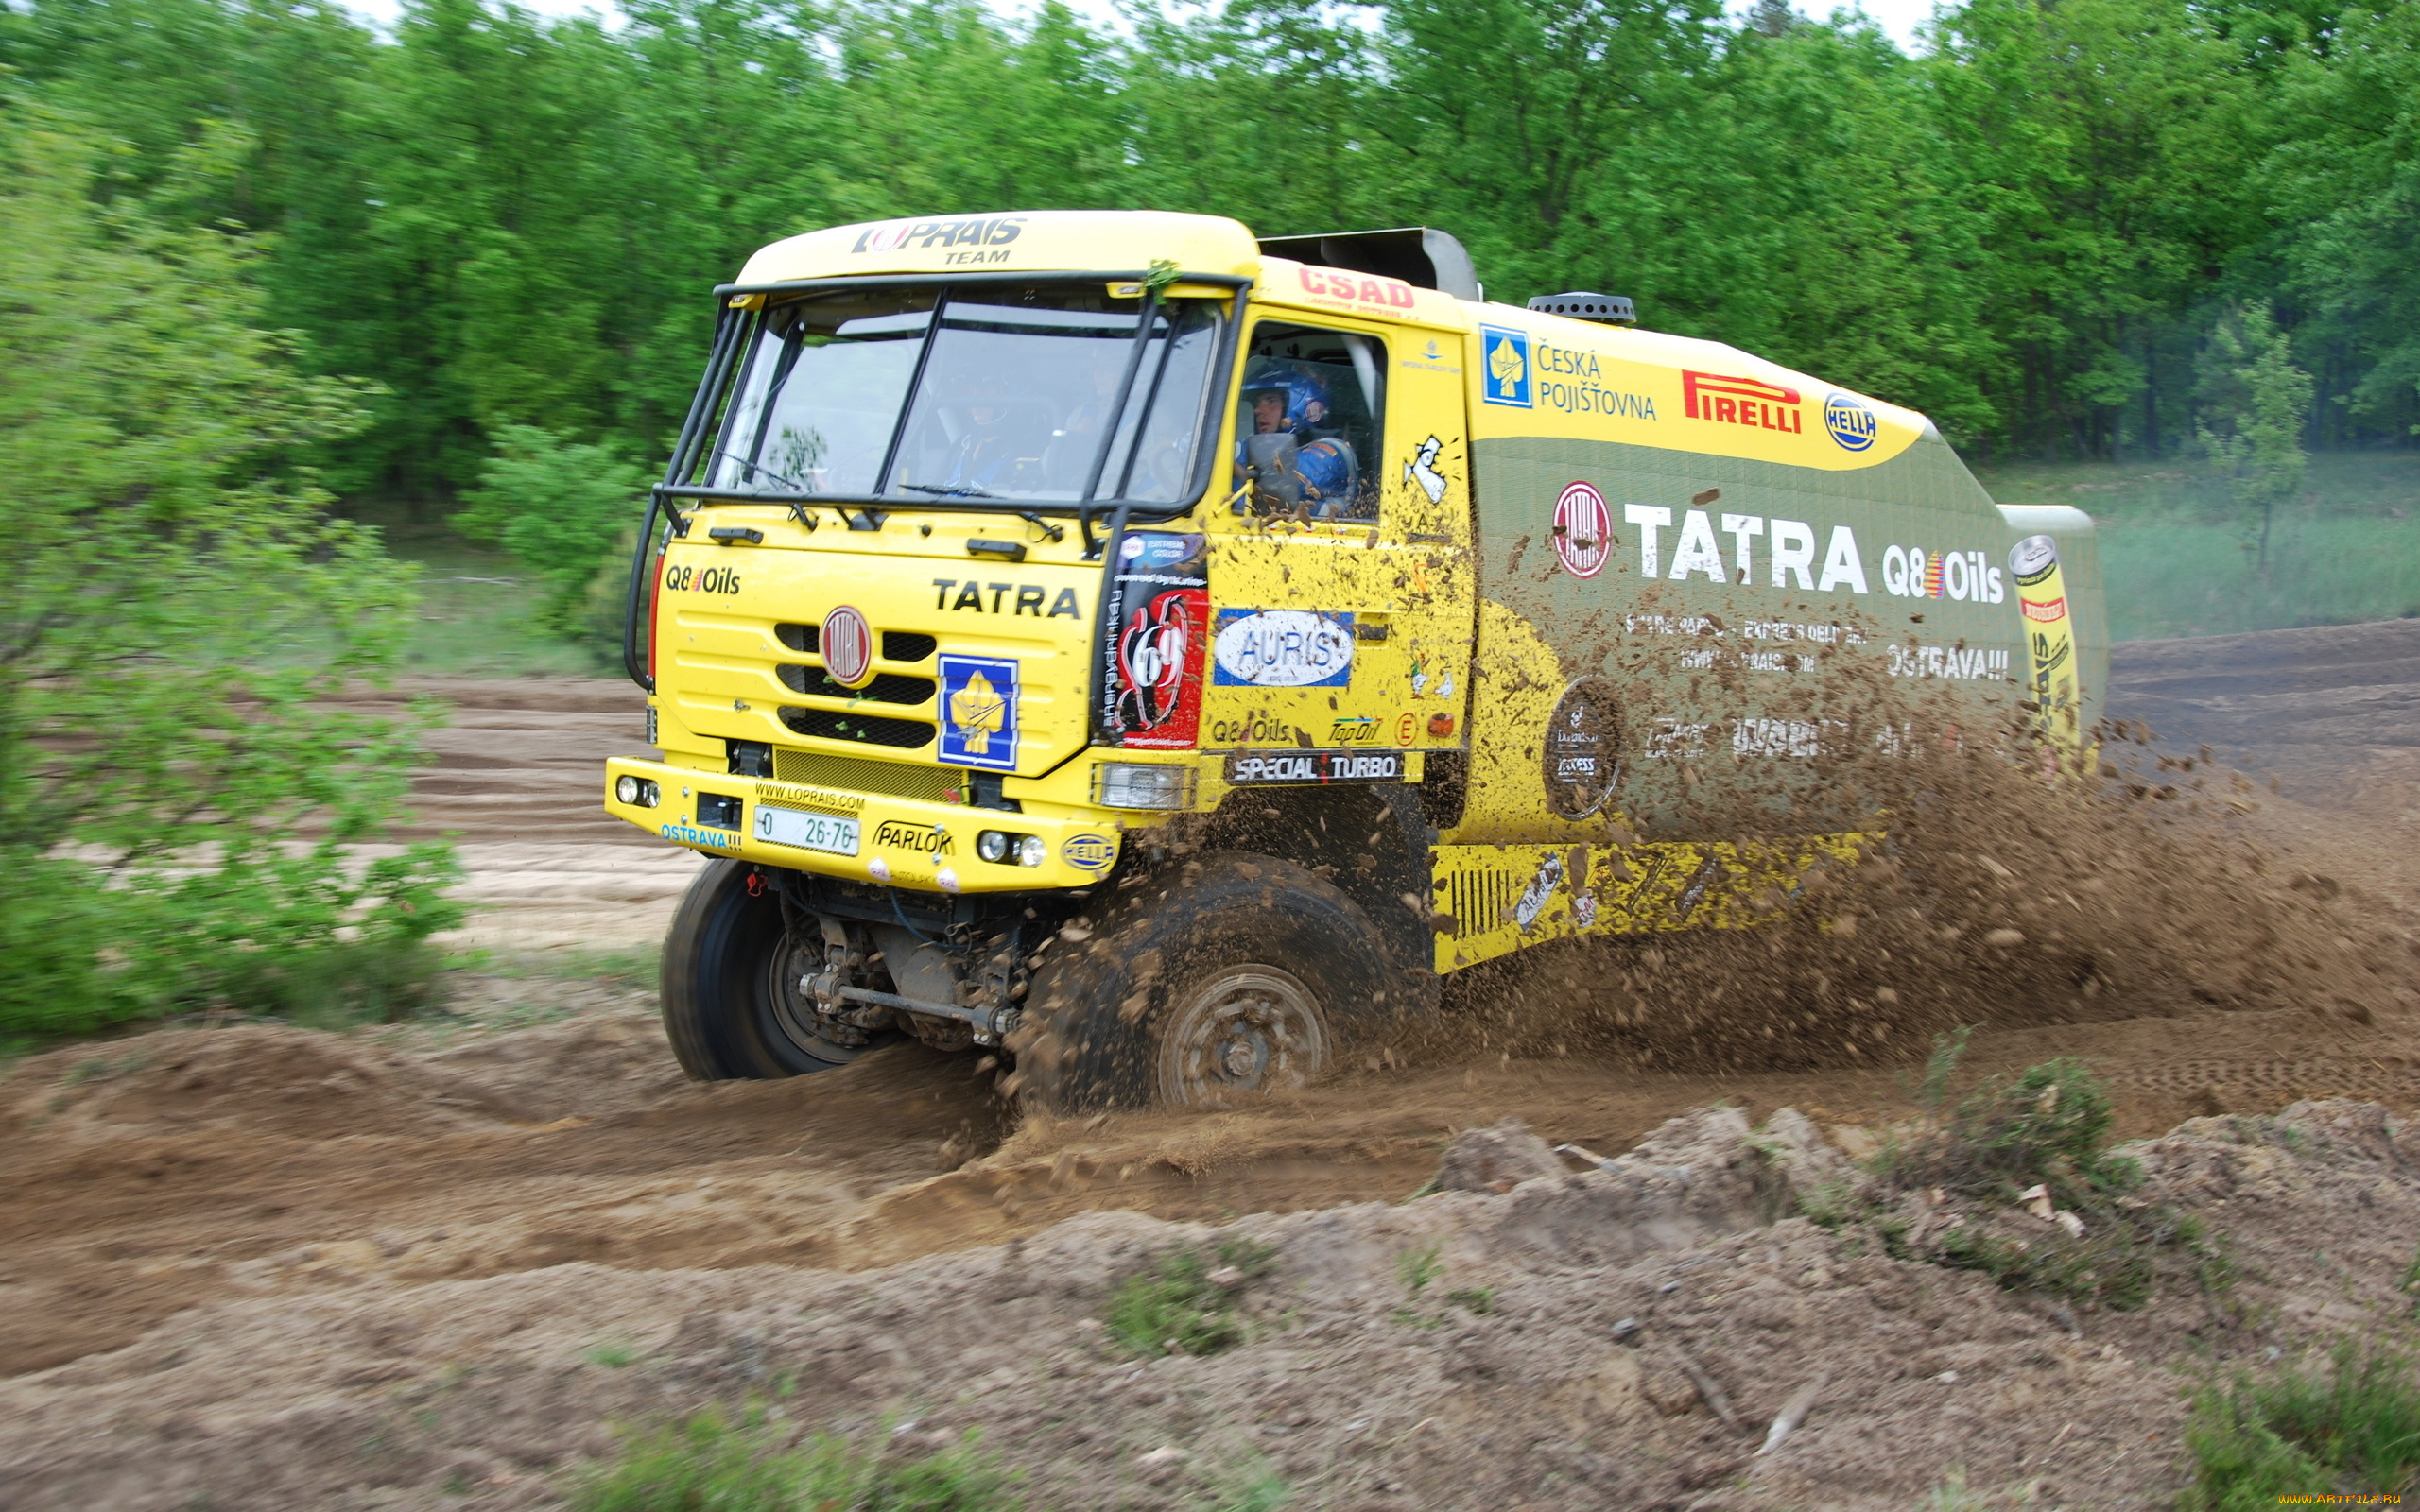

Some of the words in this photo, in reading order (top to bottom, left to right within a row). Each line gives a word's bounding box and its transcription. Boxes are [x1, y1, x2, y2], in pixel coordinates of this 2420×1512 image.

[945, 249, 1011, 266] TEAM
[1299, 268, 1415, 309] CSAD
[1537, 337, 1601, 379] ČESKÁ
[1540, 380, 1656, 421] POJIŠŤOVNA
[1682, 369, 1802, 435] PIRELLI
[1827, 408, 1876, 438] HELLA
[1624, 503, 1869, 595] TATRA
[702, 567, 741, 595] Oils
[1945, 551, 2004, 604] Oils
[932, 578, 1081, 620] TATRA
[1239, 631, 1331, 666] AURIS
[1887, 644, 2009, 680] OSTRAVA!!!
[1235, 758, 1318, 781] SPECIAL
[1331, 756, 1397, 778] TURBO
[755, 782, 866, 811] WWW.LOPRAIS.COM
[806, 818, 851, 849] 26-76
[878, 827, 953, 855] PARLOK
